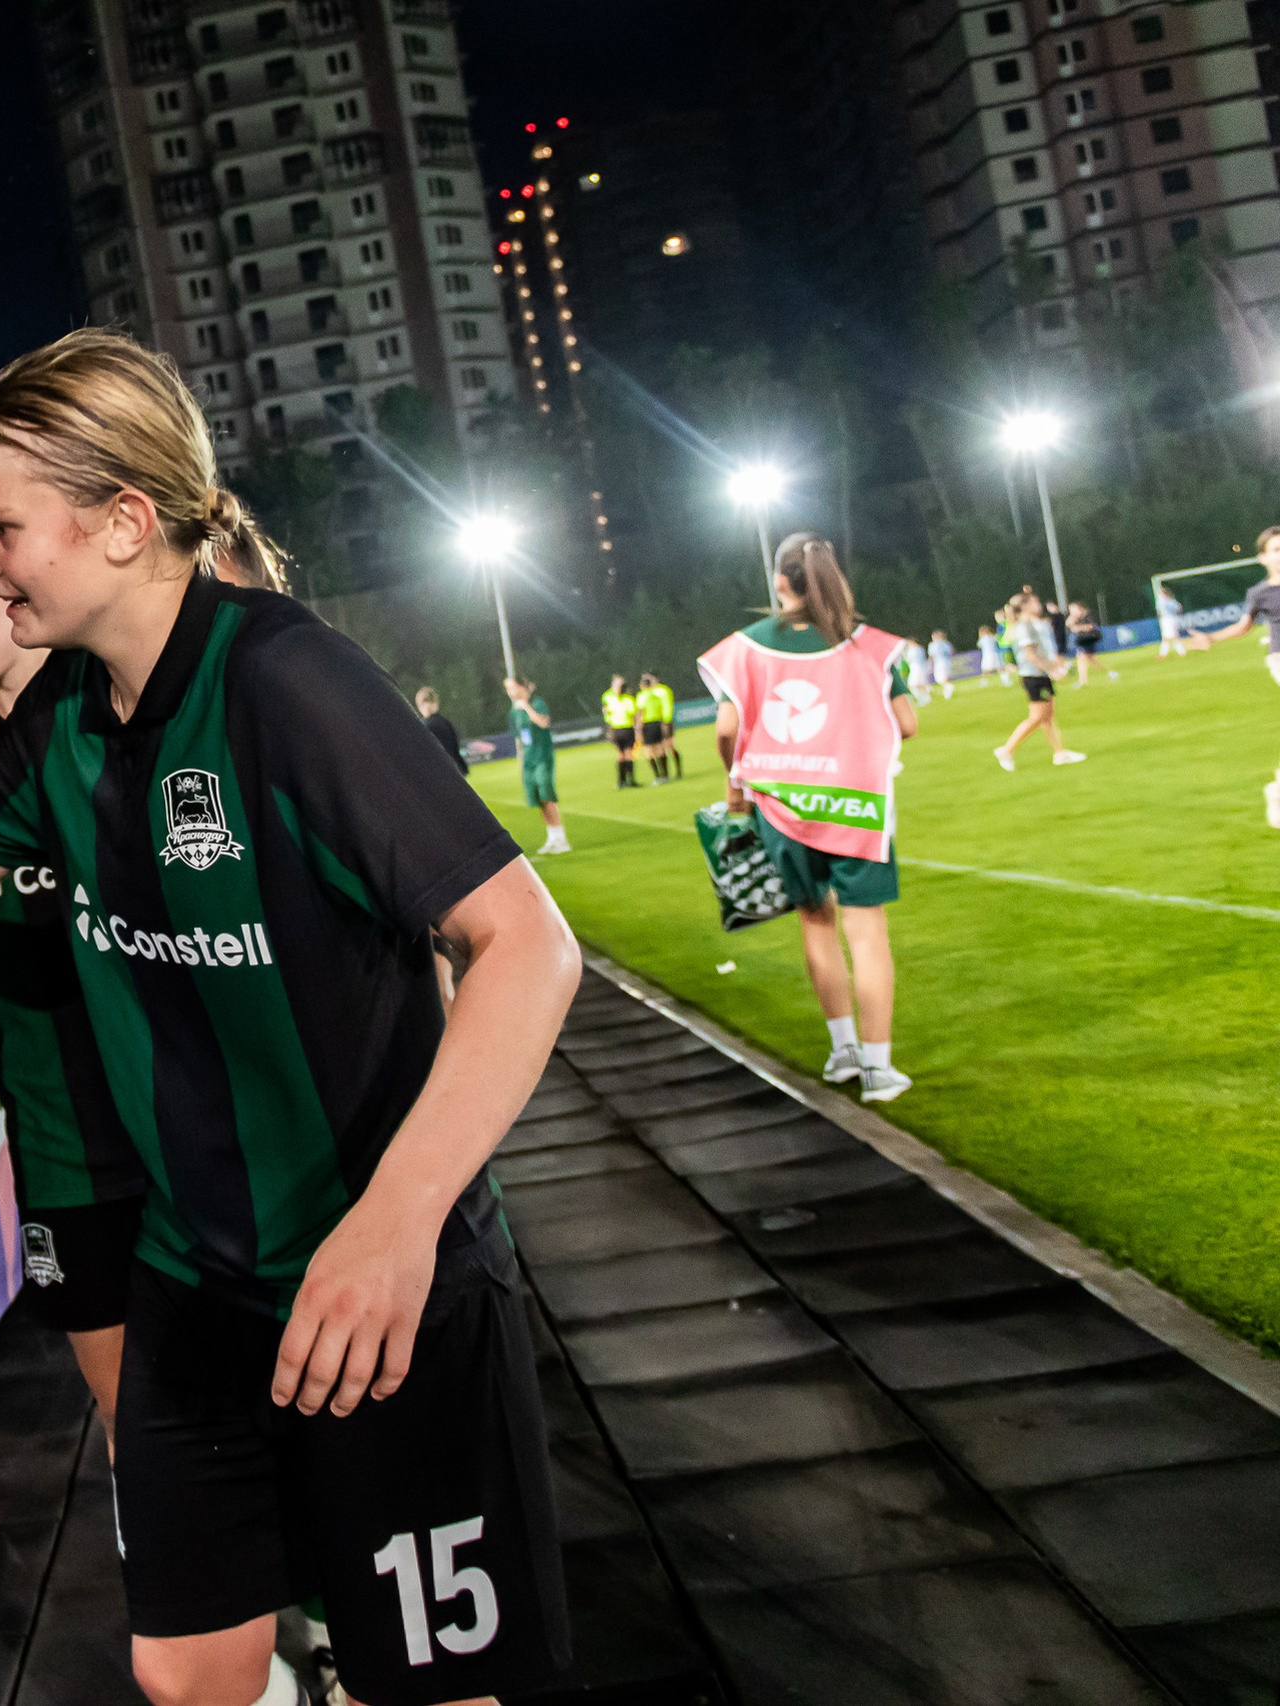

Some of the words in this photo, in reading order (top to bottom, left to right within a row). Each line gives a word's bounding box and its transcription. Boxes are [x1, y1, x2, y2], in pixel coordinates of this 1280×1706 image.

[789, 792, 879, 820] КЛУБА
[109, 914, 273, 966] Constell
[373, 1515, 500, 1666] 15
